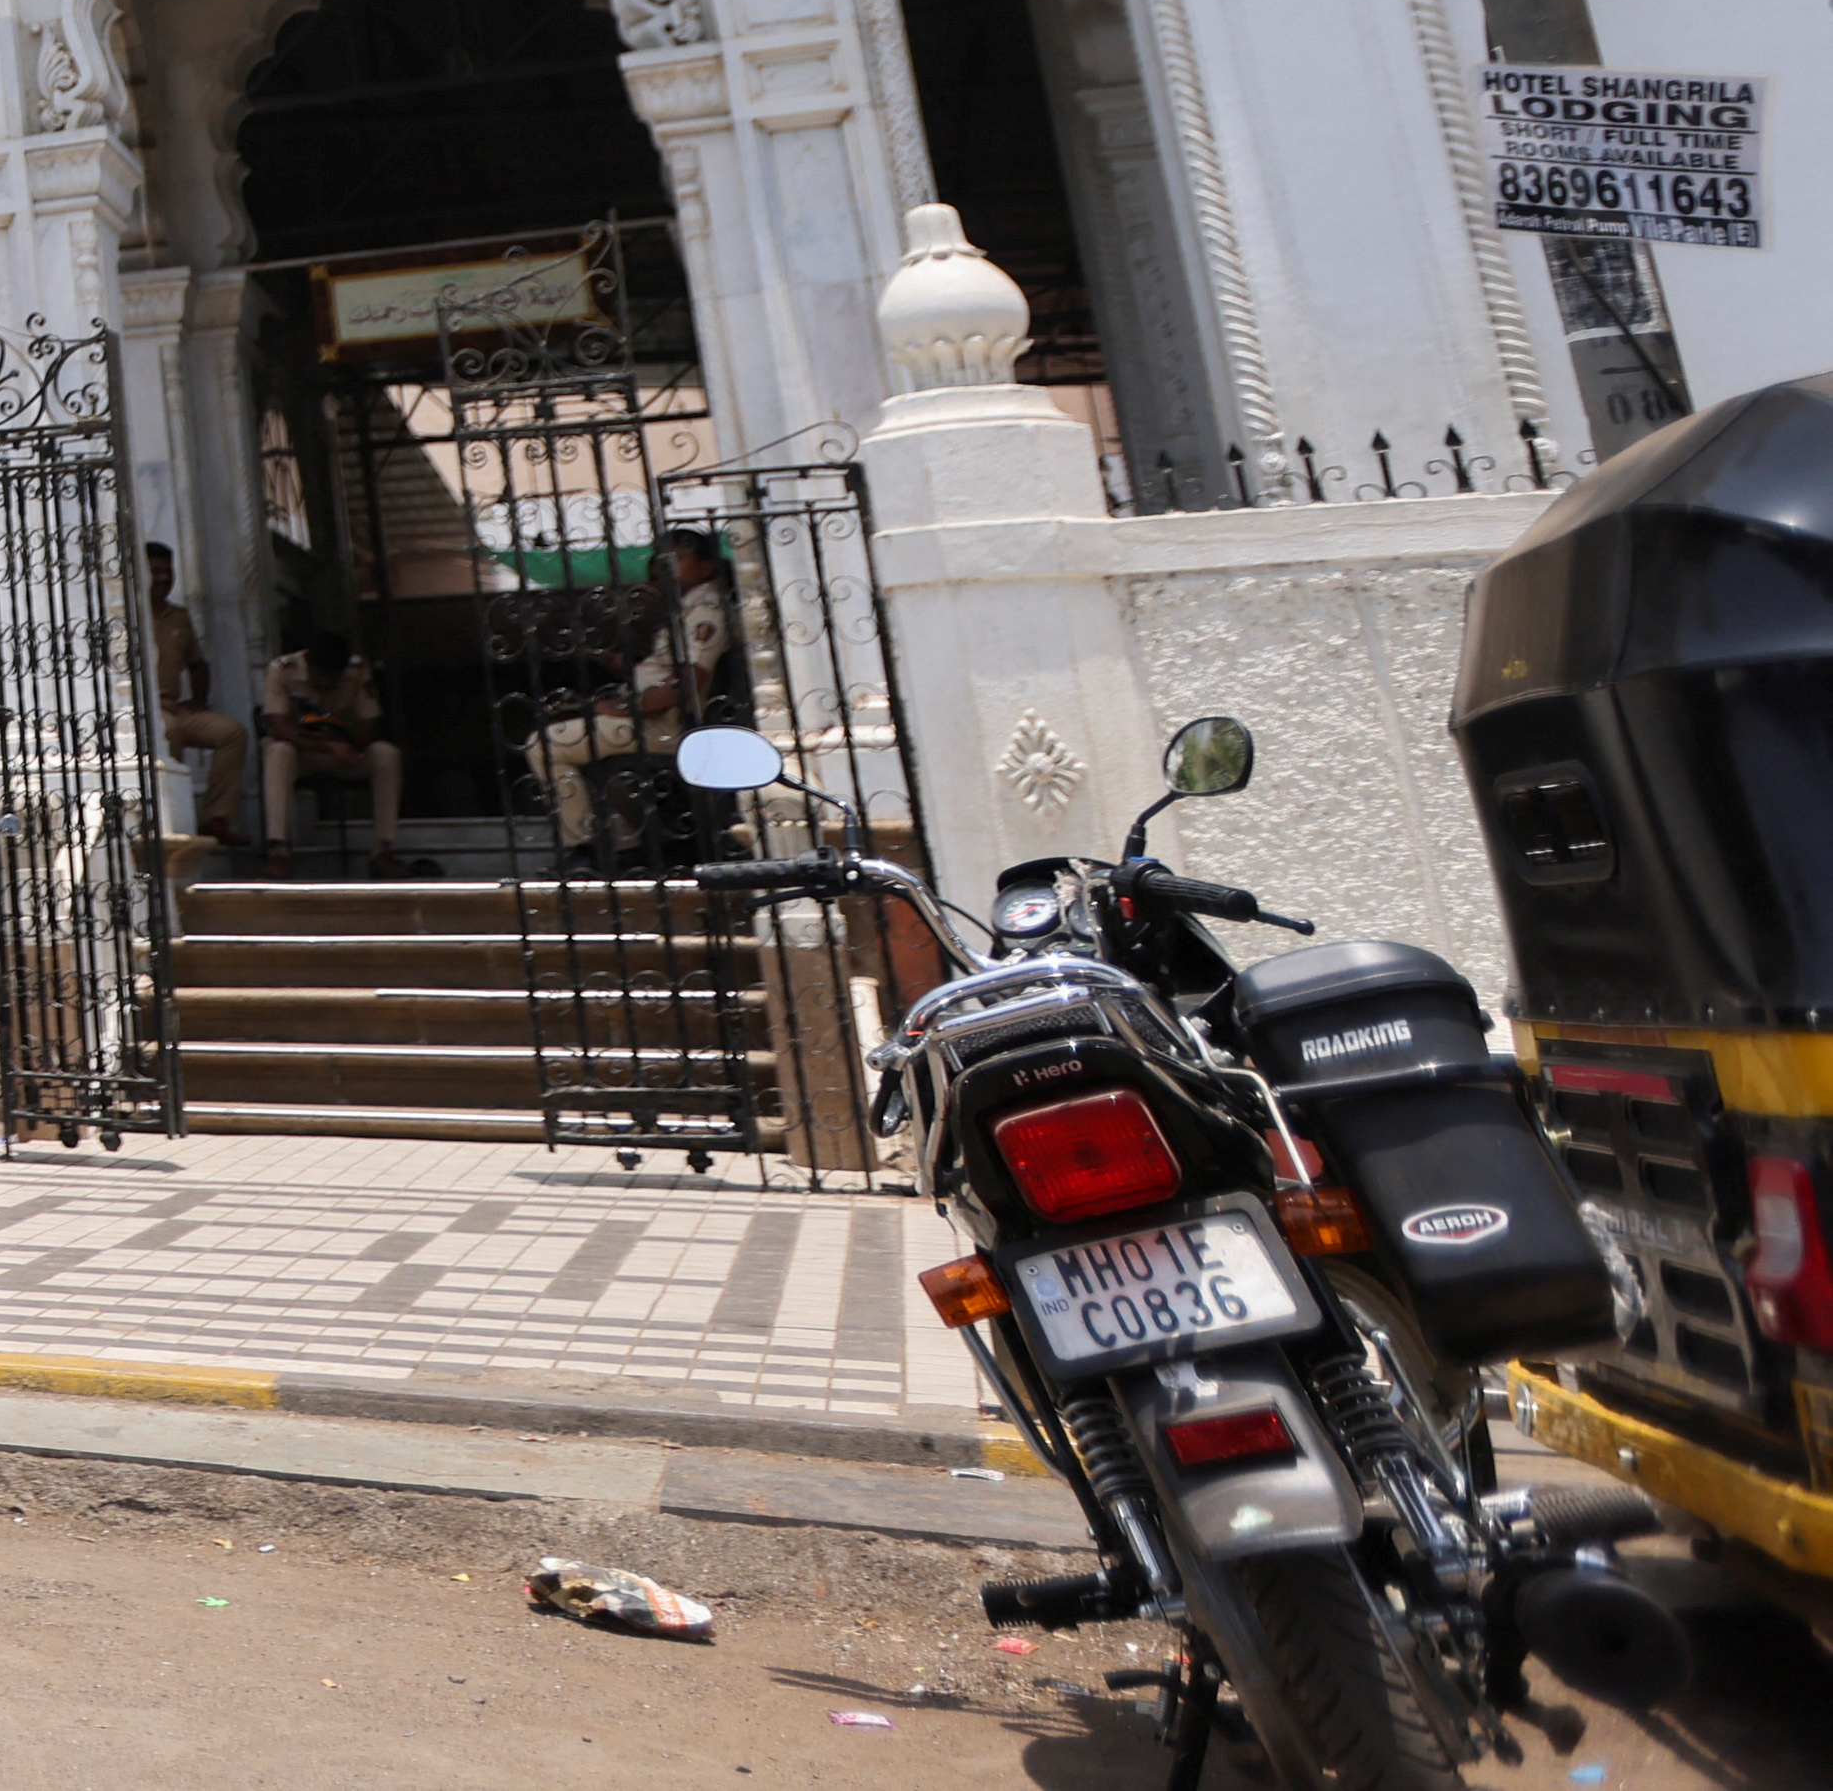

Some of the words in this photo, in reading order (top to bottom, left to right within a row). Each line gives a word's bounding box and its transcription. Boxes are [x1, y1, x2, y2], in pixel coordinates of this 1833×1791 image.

[1484, 70, 1572, 96] HOTEL
[1582, 76, 1755, 104] SHANGRILA
[1492, 94, 1750, 129] LODGING
[1499, 121, 1580, 142] SHORT
[1604, 129, 1666, 147] FULL
[1674, 133, 1743, 151] TIME
[1506, 141, 1592, 161] ROOMS
[1600, 149, 1740, 170] AVAILABLE
[1499, 161, 1751, 219] 8369611643
[1586, 216, 1630, 237] Pump
[1301, 1019, 1412, 1062] ROADKING
[1034, 1059, 1083, 1080] Hero
[1051, 1222, 1224, 1299] MH01E
[1040, 1298, 1071, 1316] IND
[1081, 1275, 1250, 1348] C0836
